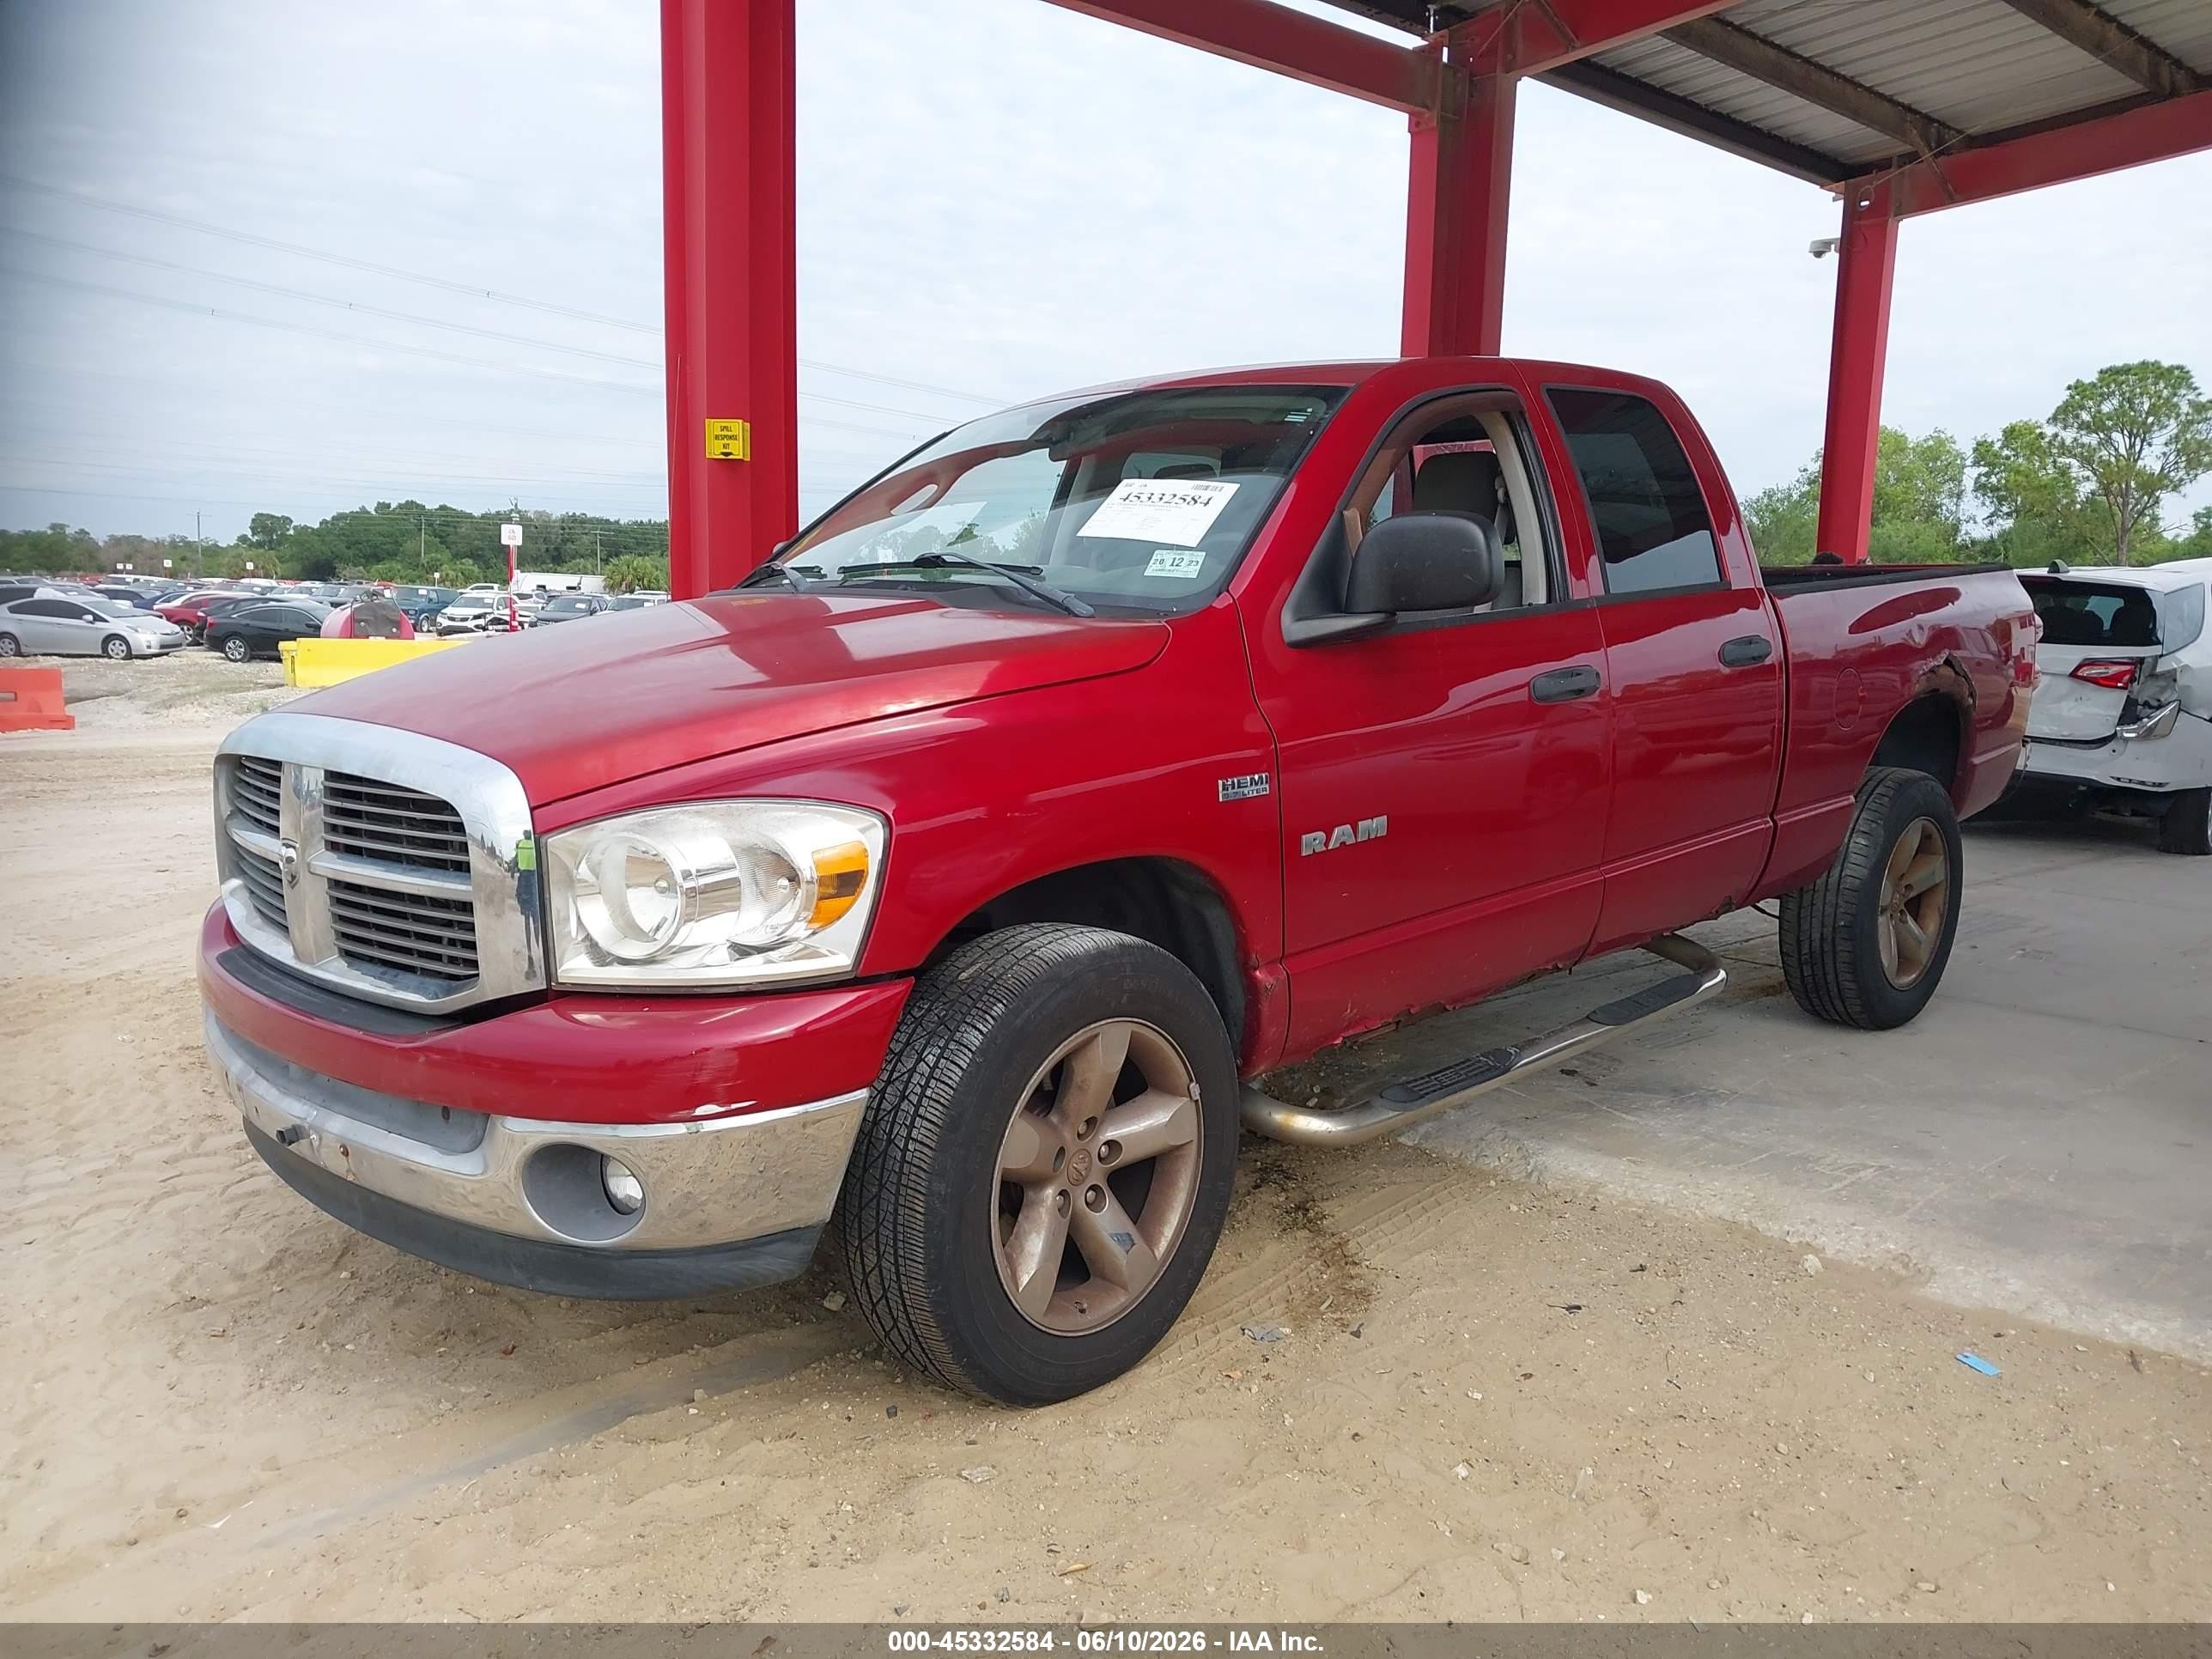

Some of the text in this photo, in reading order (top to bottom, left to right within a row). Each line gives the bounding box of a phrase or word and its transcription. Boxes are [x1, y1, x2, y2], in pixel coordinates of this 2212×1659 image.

[1119, 491, 1213, 507] 45332584
[1169, 556, 1185, 568] 12
[1221, 774, 1268, 791] HEMI
[1242, 787, 1268, 797] LITER
[1300, 815, 1388, 856] RAM
